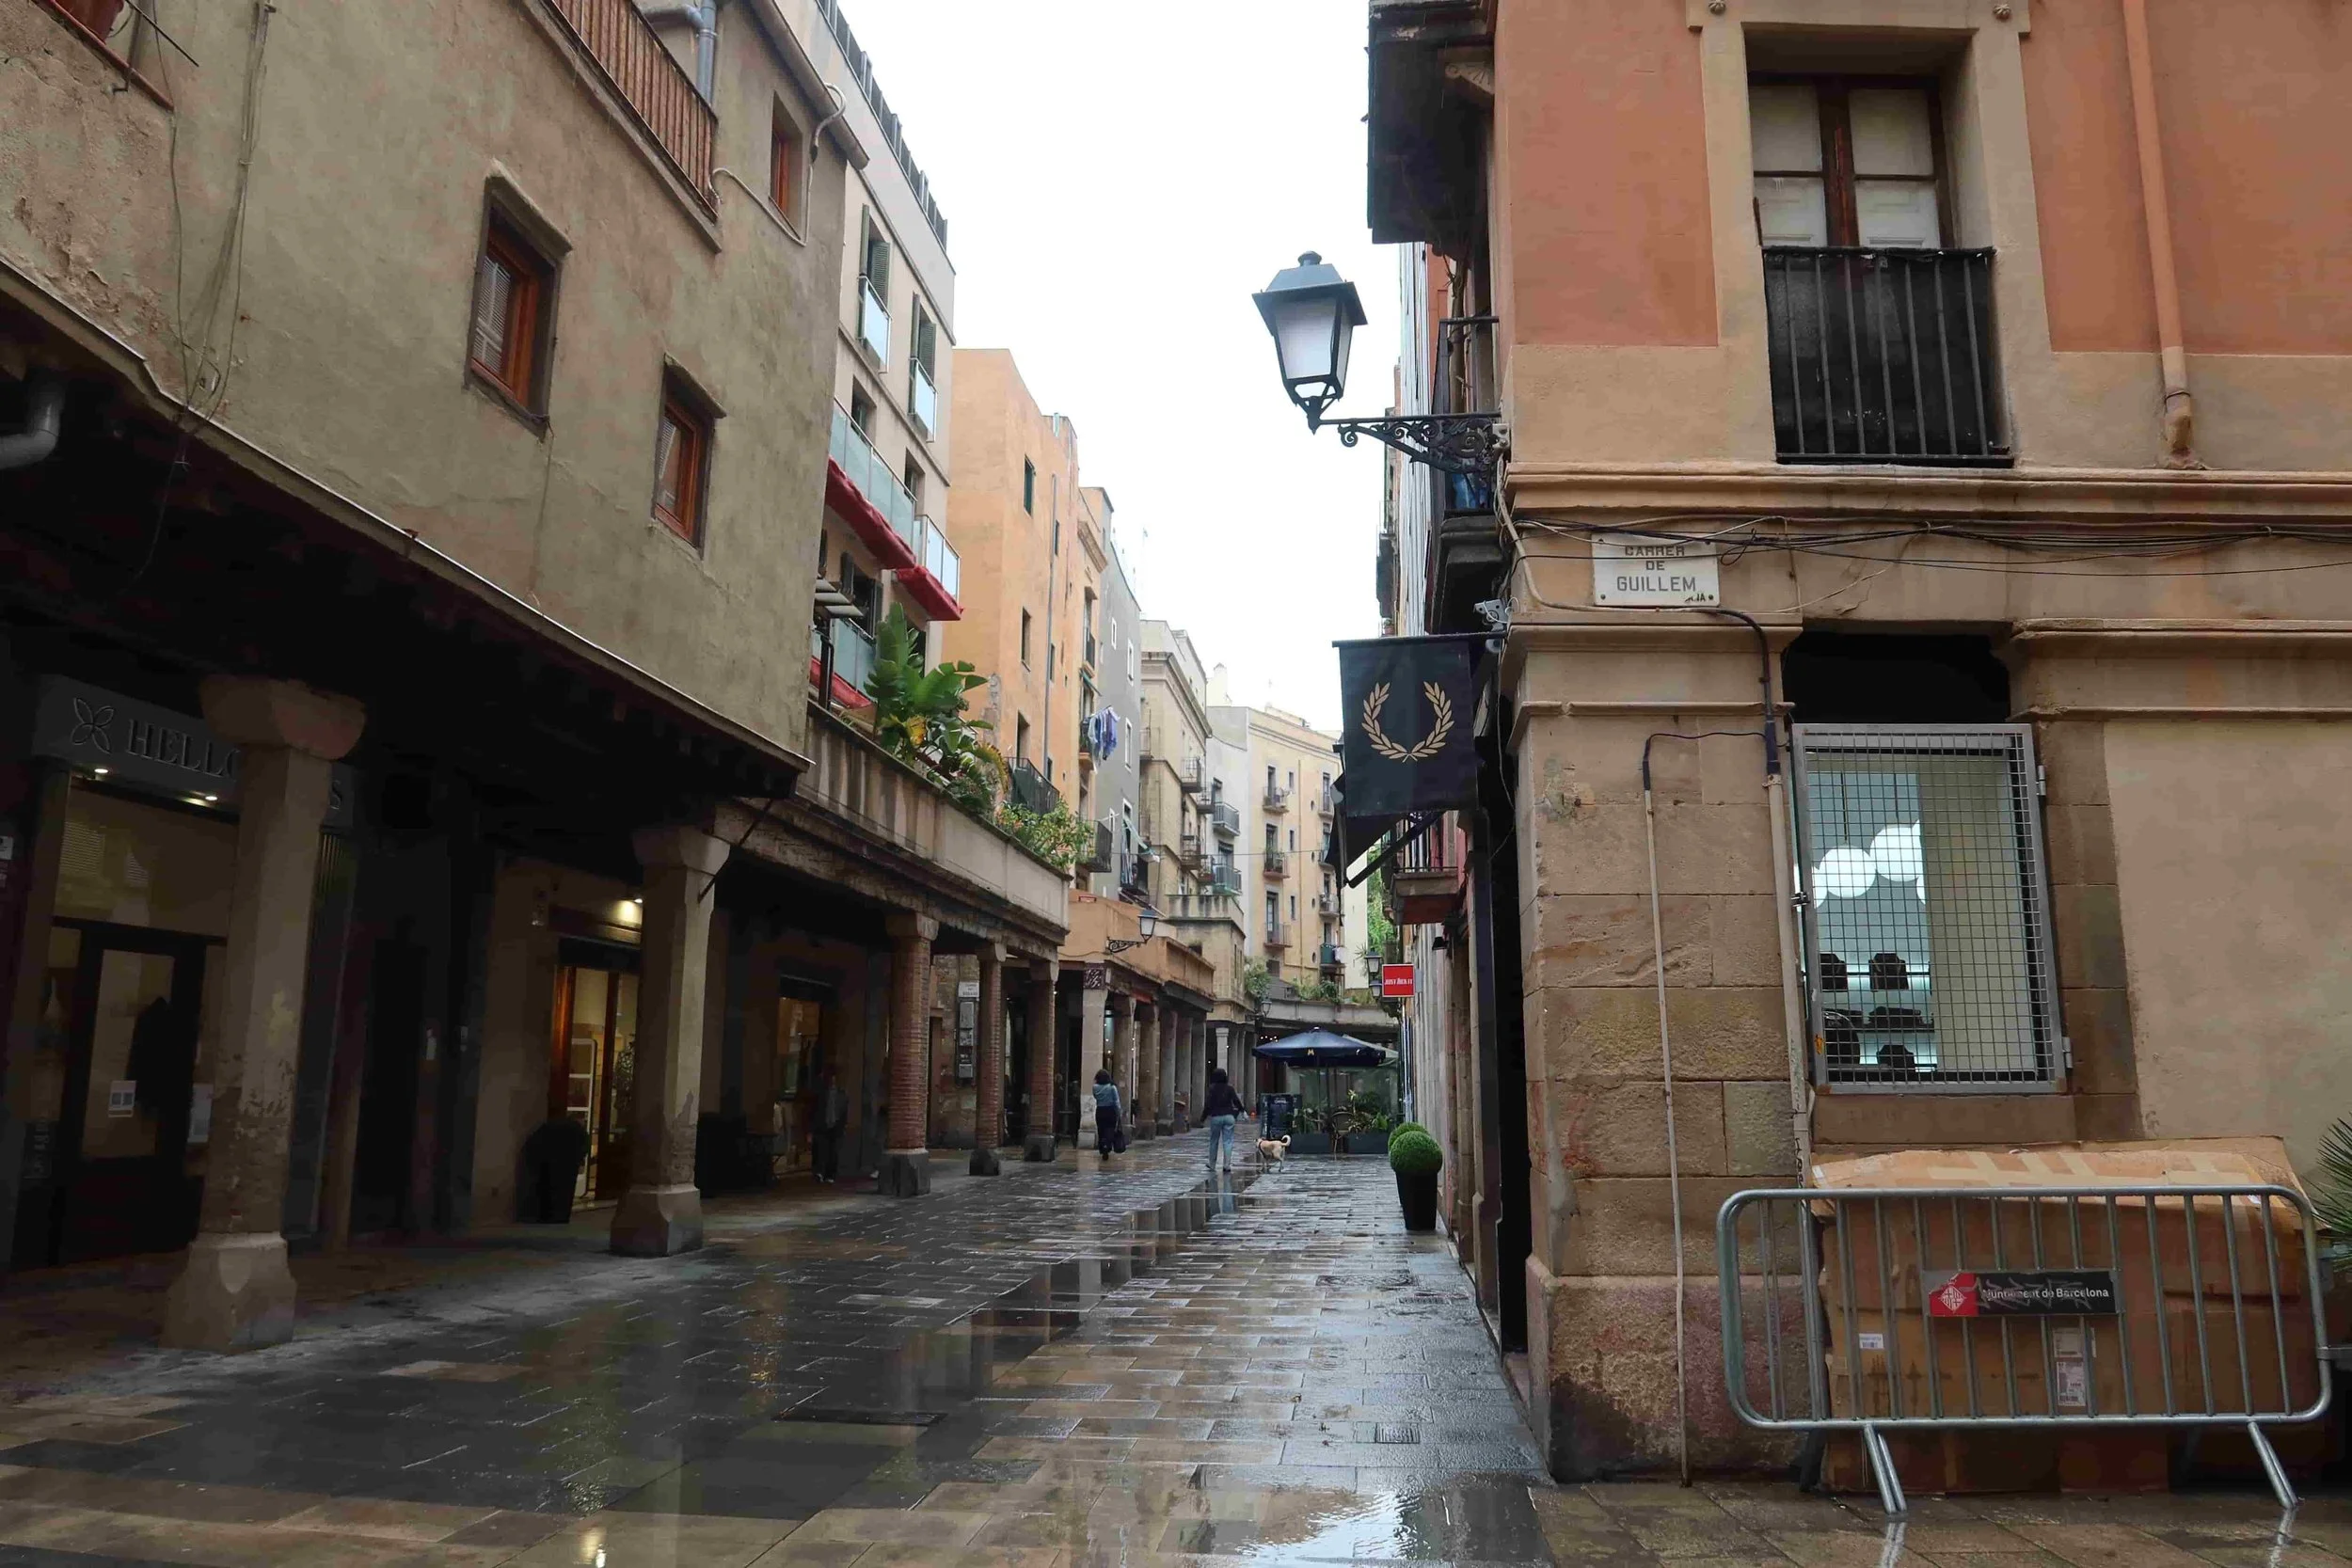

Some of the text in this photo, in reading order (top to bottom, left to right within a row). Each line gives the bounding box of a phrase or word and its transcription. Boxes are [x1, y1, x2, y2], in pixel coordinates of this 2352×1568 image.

[1625, 546, 1685, 557] CARRER
[1645, 560, 1665, 571] DE
[1616, 576, 1696, 592] GUILLEM
[2042, 1289, 2054, 1298] de
[2056, 1288, 2109, 1298] Barcelona
